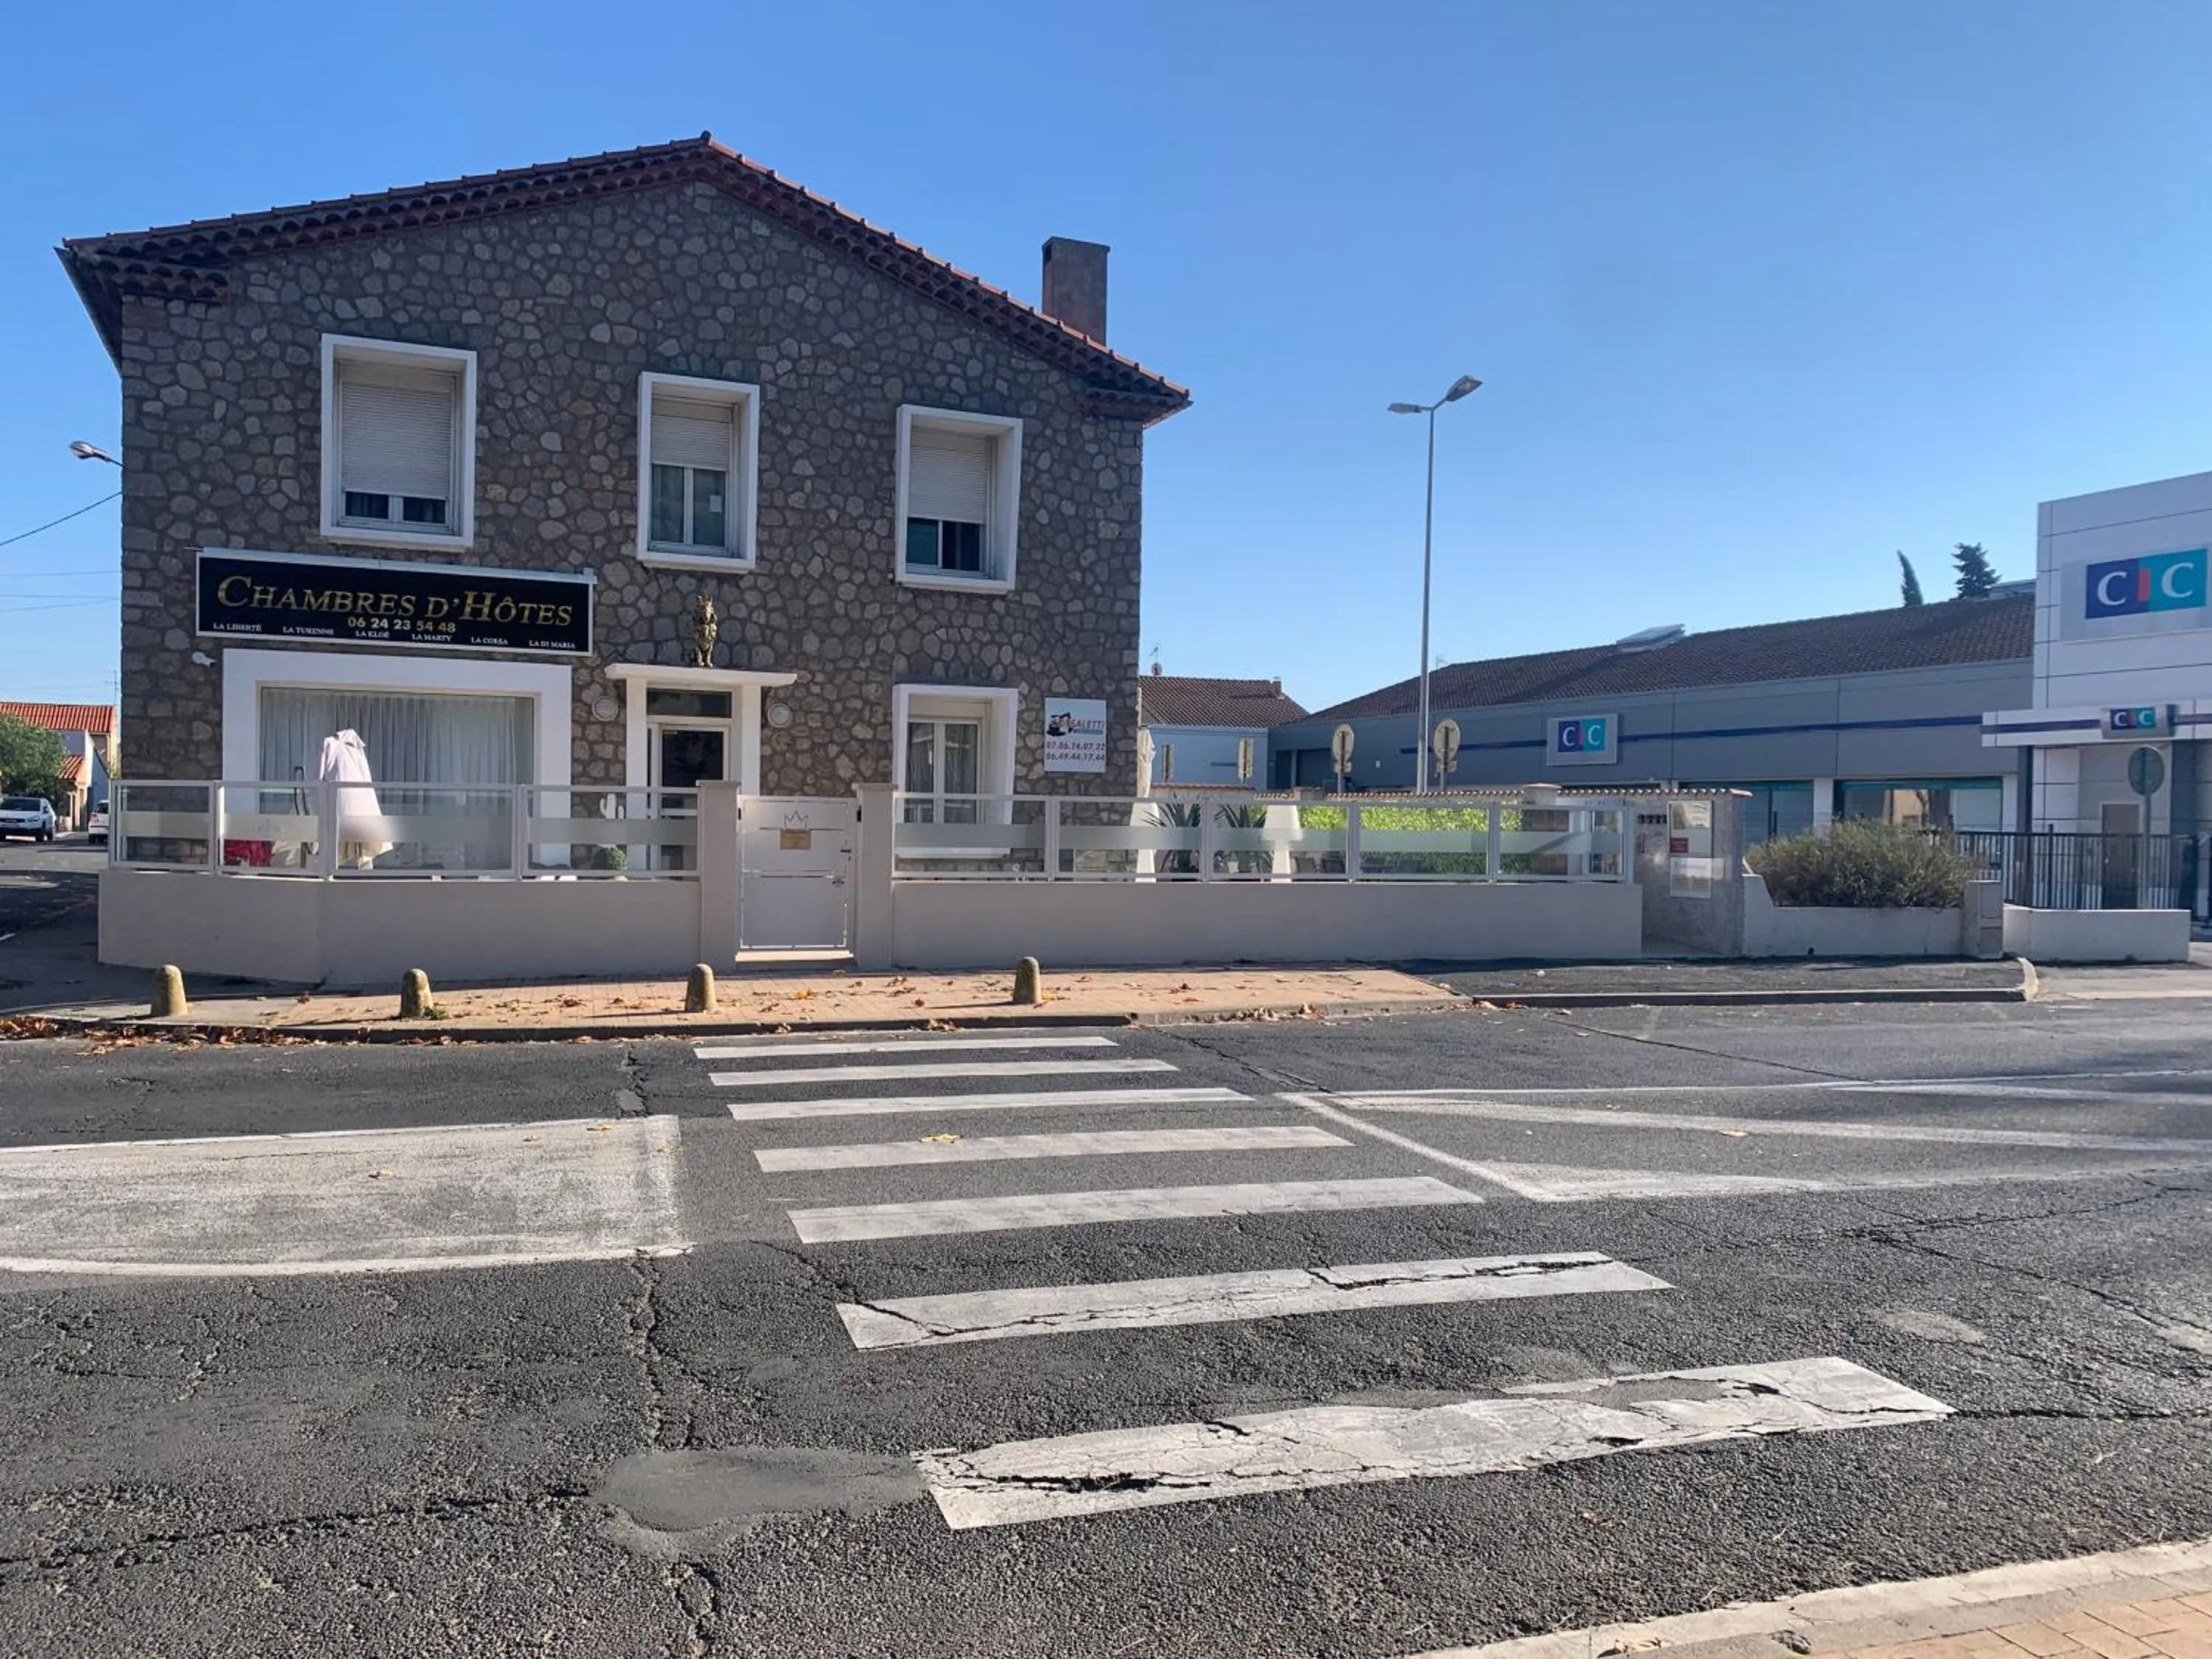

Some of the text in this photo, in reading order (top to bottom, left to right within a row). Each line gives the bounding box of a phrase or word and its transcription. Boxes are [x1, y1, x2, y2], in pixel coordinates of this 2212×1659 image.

[2097, 563, 2194, 606] CIC
[218, 575, 573, 626] CHAMBRES D'HÔTES
[347, 616, 456, 633] 06 24 23 54 48
[551, 641, 576, 650] MARIA
[2115, 709, 2154, 727] CIC
[1562, 724, 1601, 747] CIC
